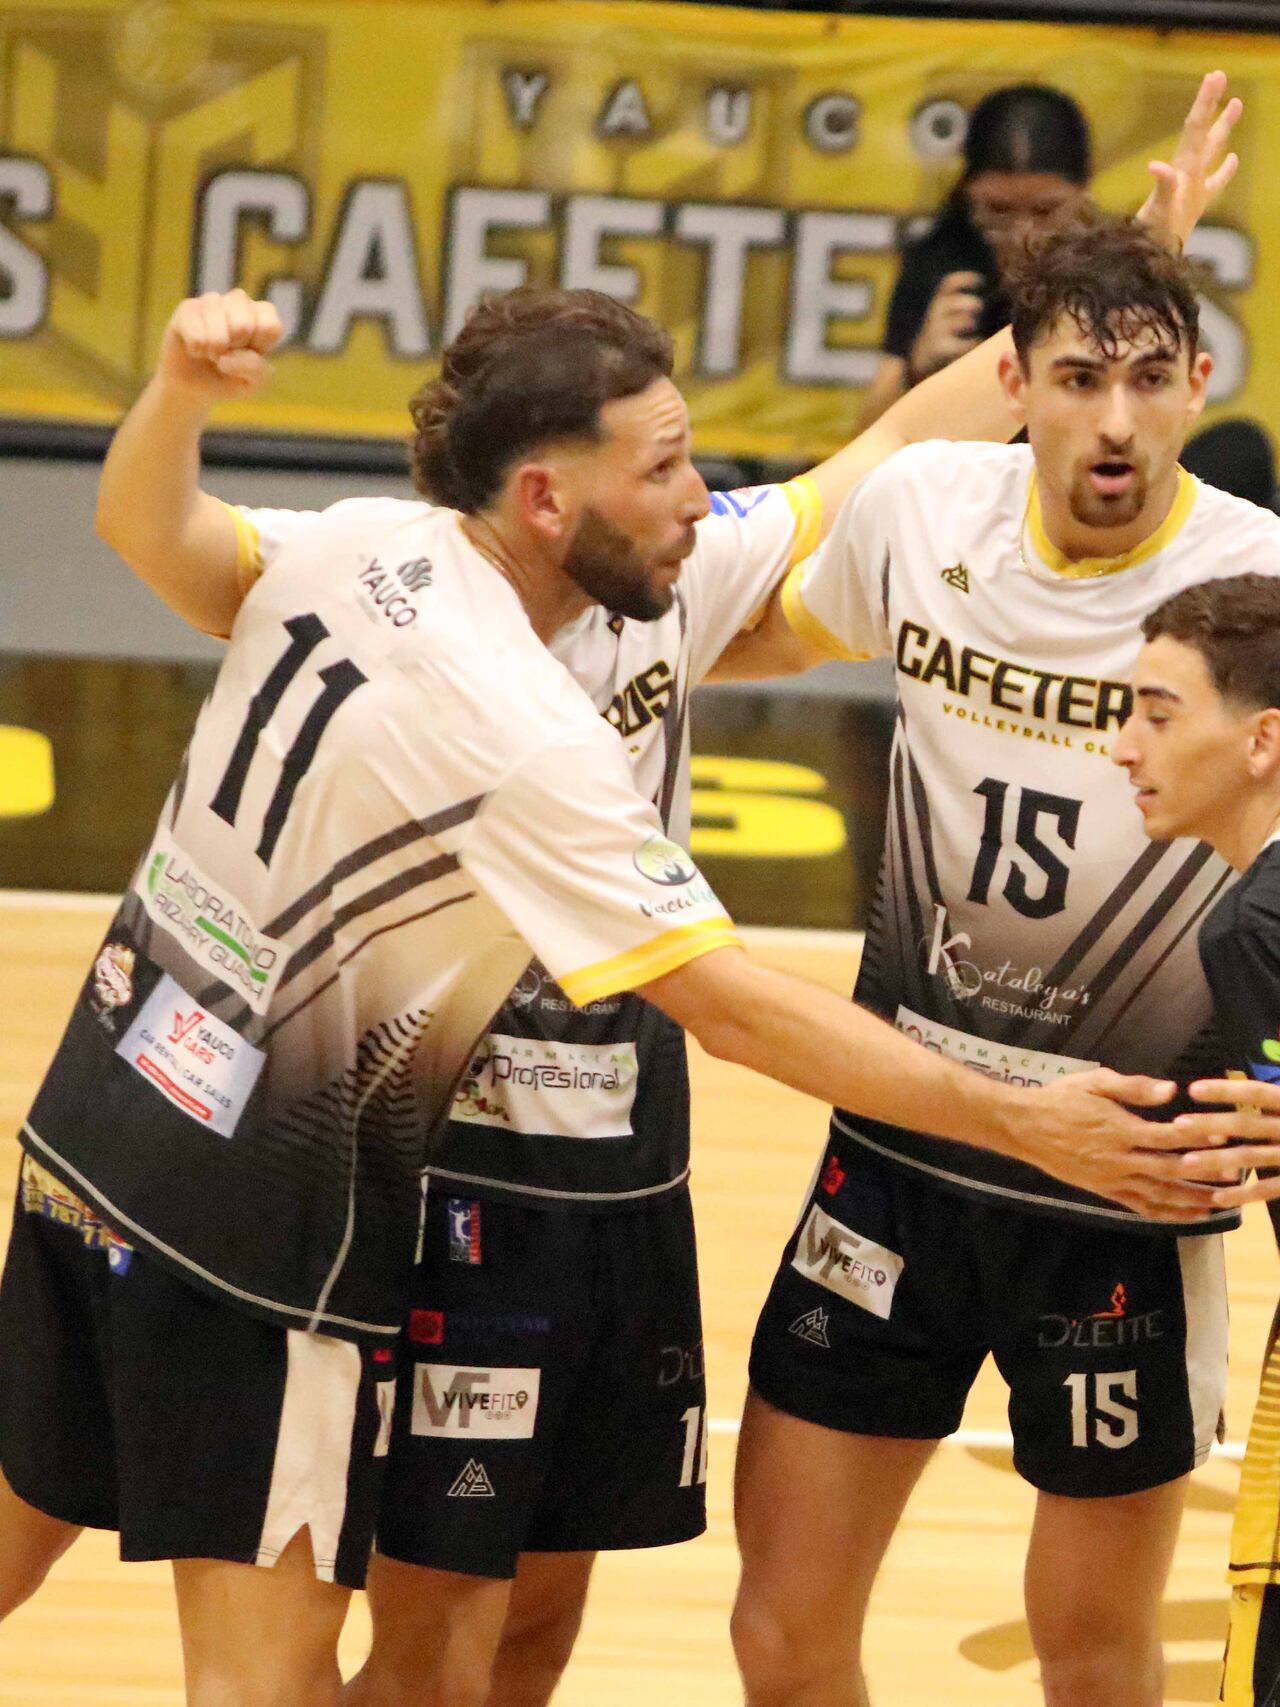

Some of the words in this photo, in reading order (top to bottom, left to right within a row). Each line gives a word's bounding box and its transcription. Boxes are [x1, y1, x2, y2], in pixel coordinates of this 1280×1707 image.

[358, 556, 418, 629] YAUCO
[896, 617, 1136, 734] CAFETER
[208, 611, 371, 872] 11
[942, 702, 1073, 748] VOLLEYBALL
[965, 775, 1084, 921] 15
[981, 995, 1073, 1027] RESTAURANT
[491, 1054, 621, 1091] Profesional
[1062, 1368, 1140, 1450] 15
